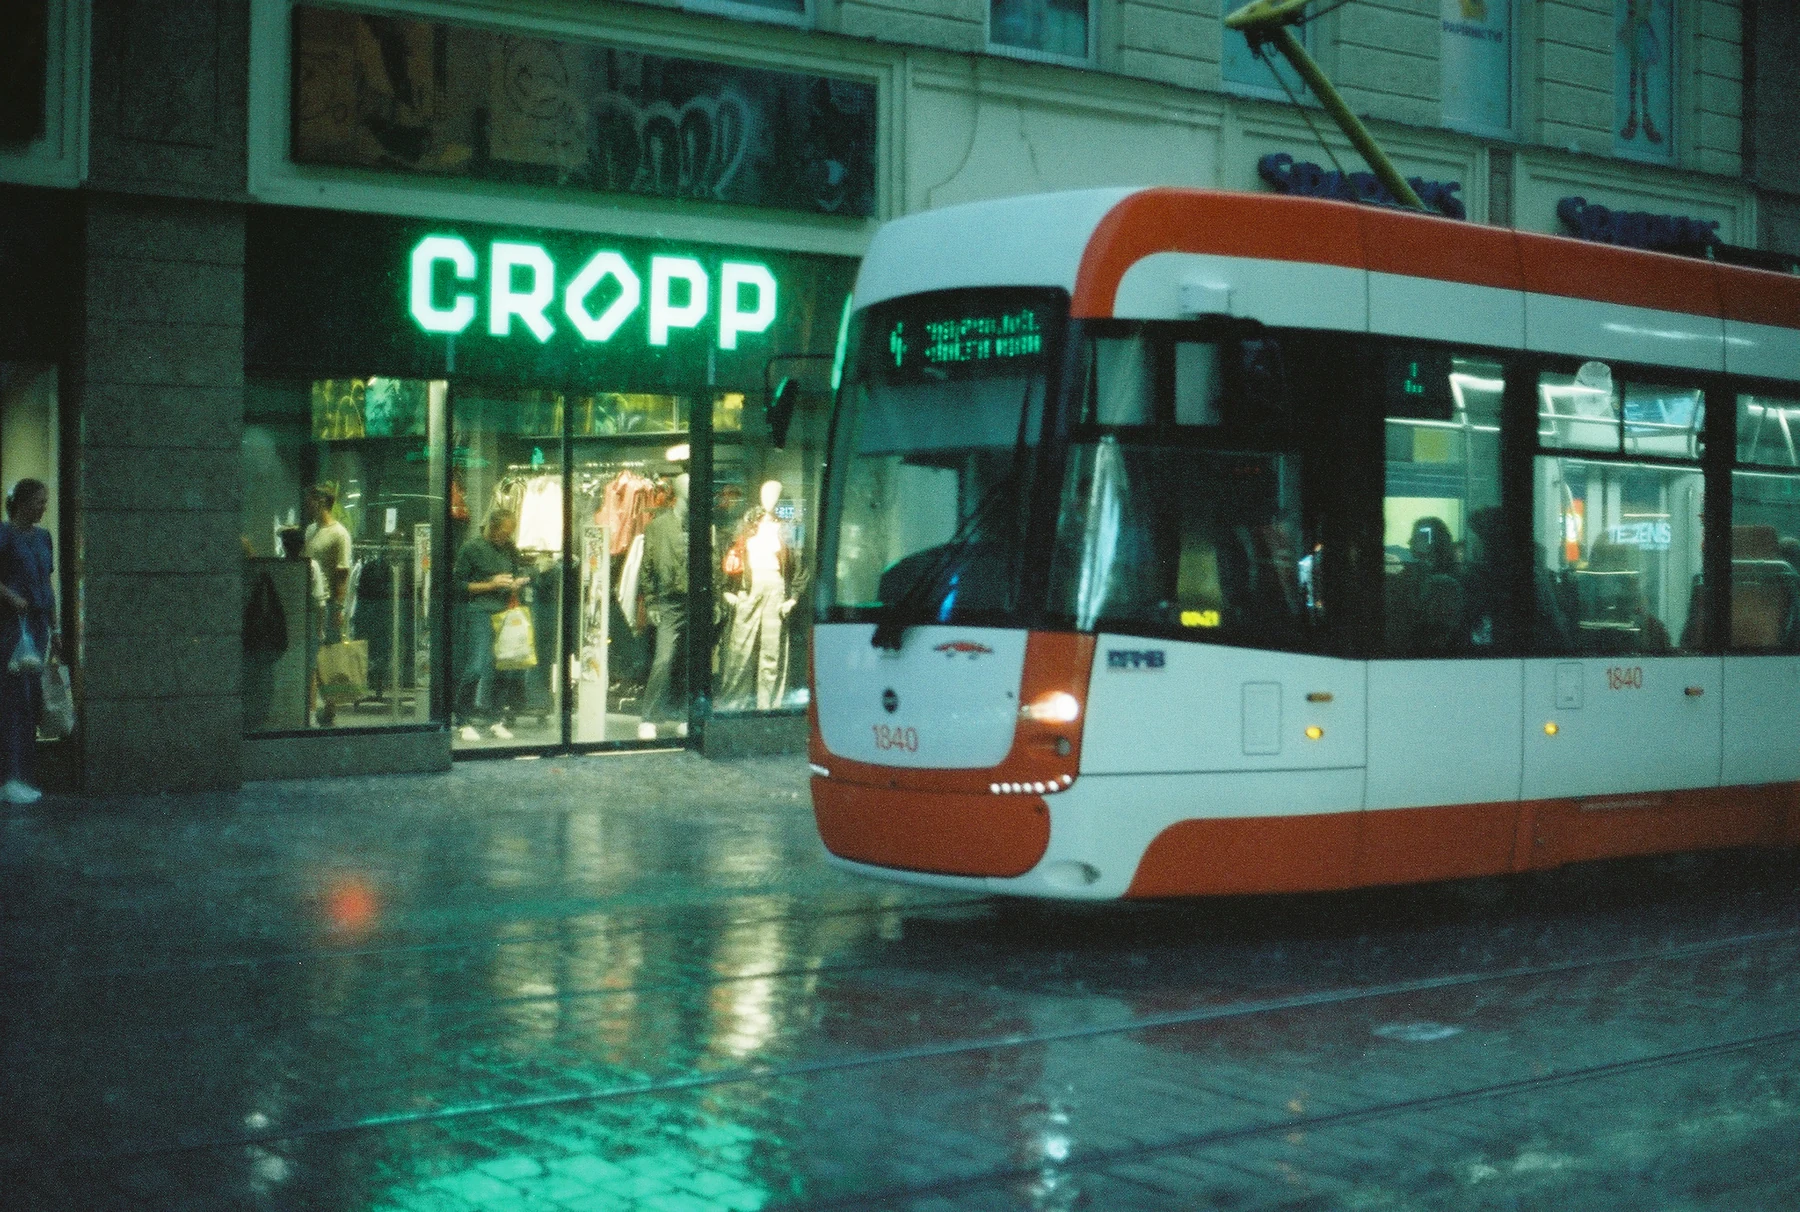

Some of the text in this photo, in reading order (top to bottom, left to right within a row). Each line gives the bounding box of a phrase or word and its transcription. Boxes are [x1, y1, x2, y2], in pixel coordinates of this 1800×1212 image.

[409, 234, 779, 351] CROPP
[1605, 666, 1644, 691] 1840
[872, 723, 919, 753] 1840
